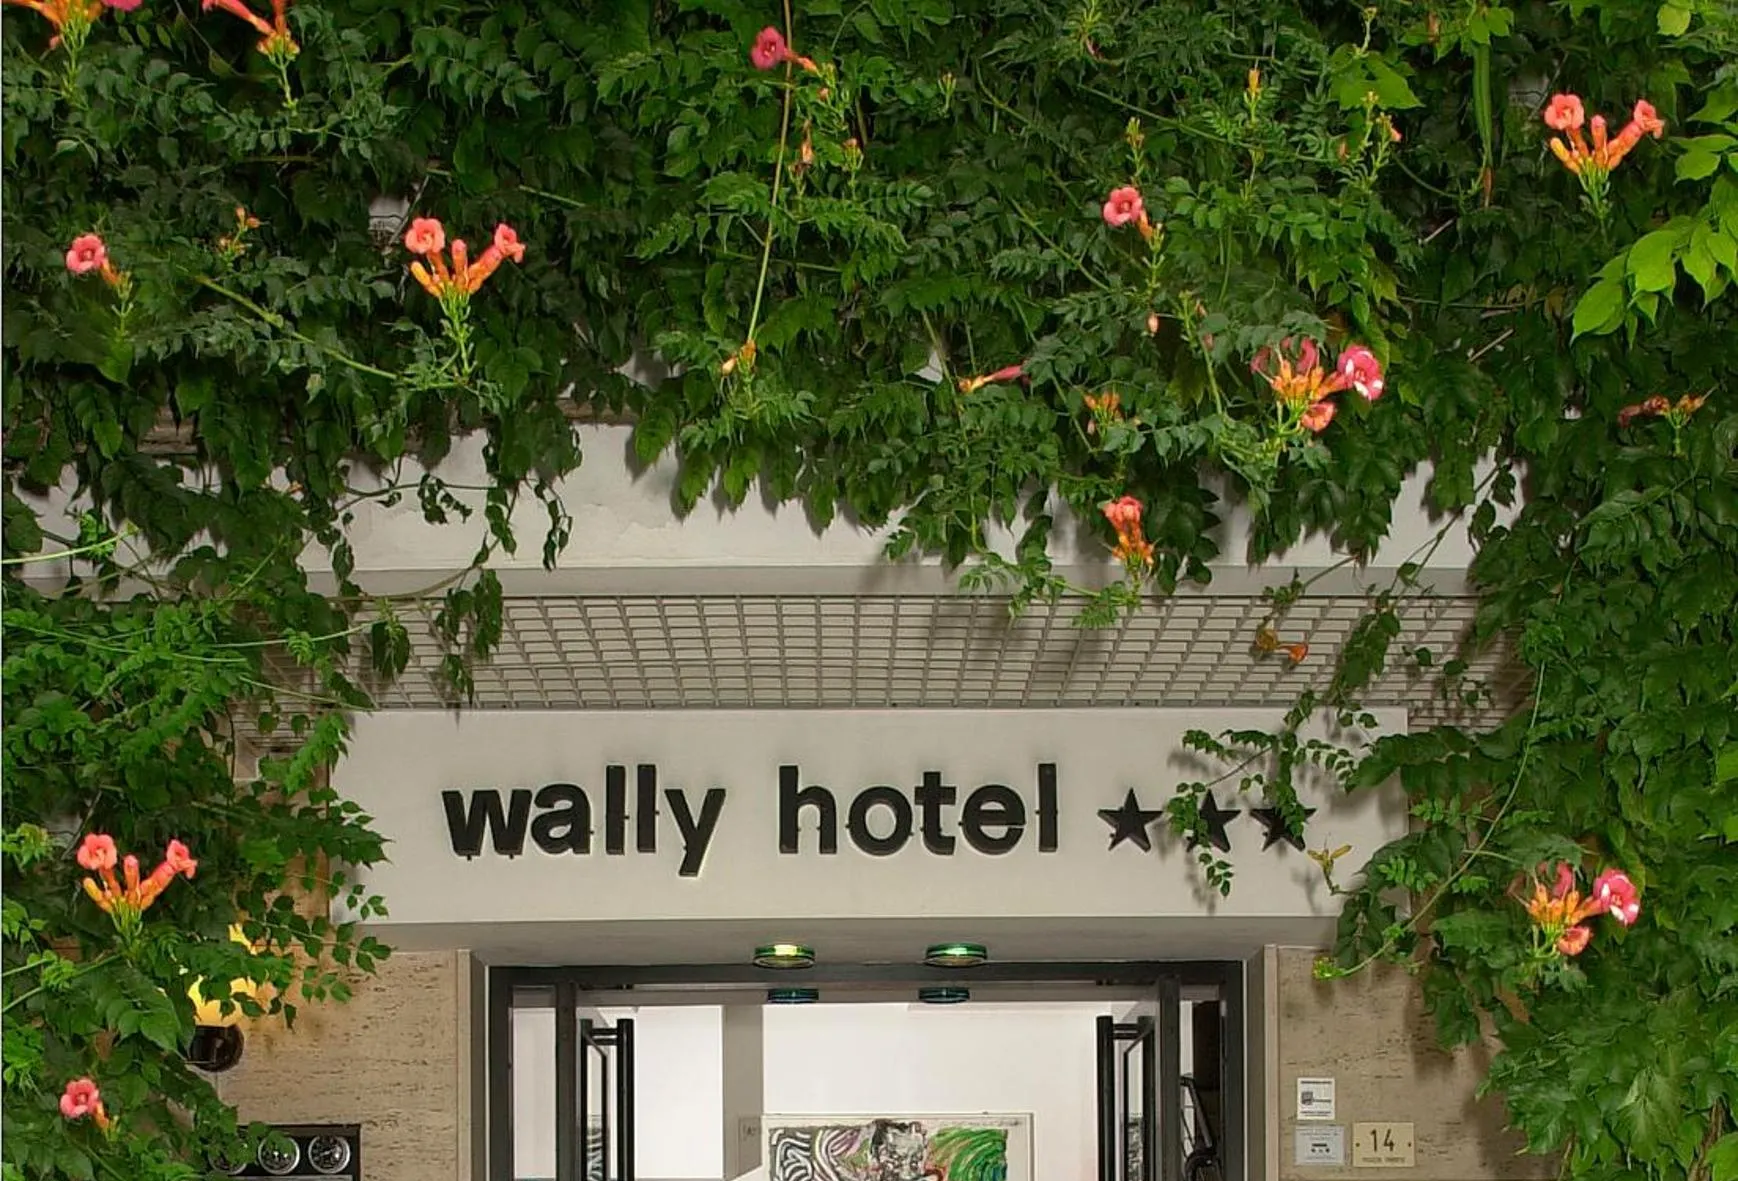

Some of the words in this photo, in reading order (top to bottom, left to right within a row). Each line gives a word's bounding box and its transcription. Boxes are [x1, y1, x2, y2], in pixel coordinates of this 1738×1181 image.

[441, 764, 727, 877] wally
[779, 762, 1058, 857] hotel
[1370, 1128, 1395, 1152] 14
